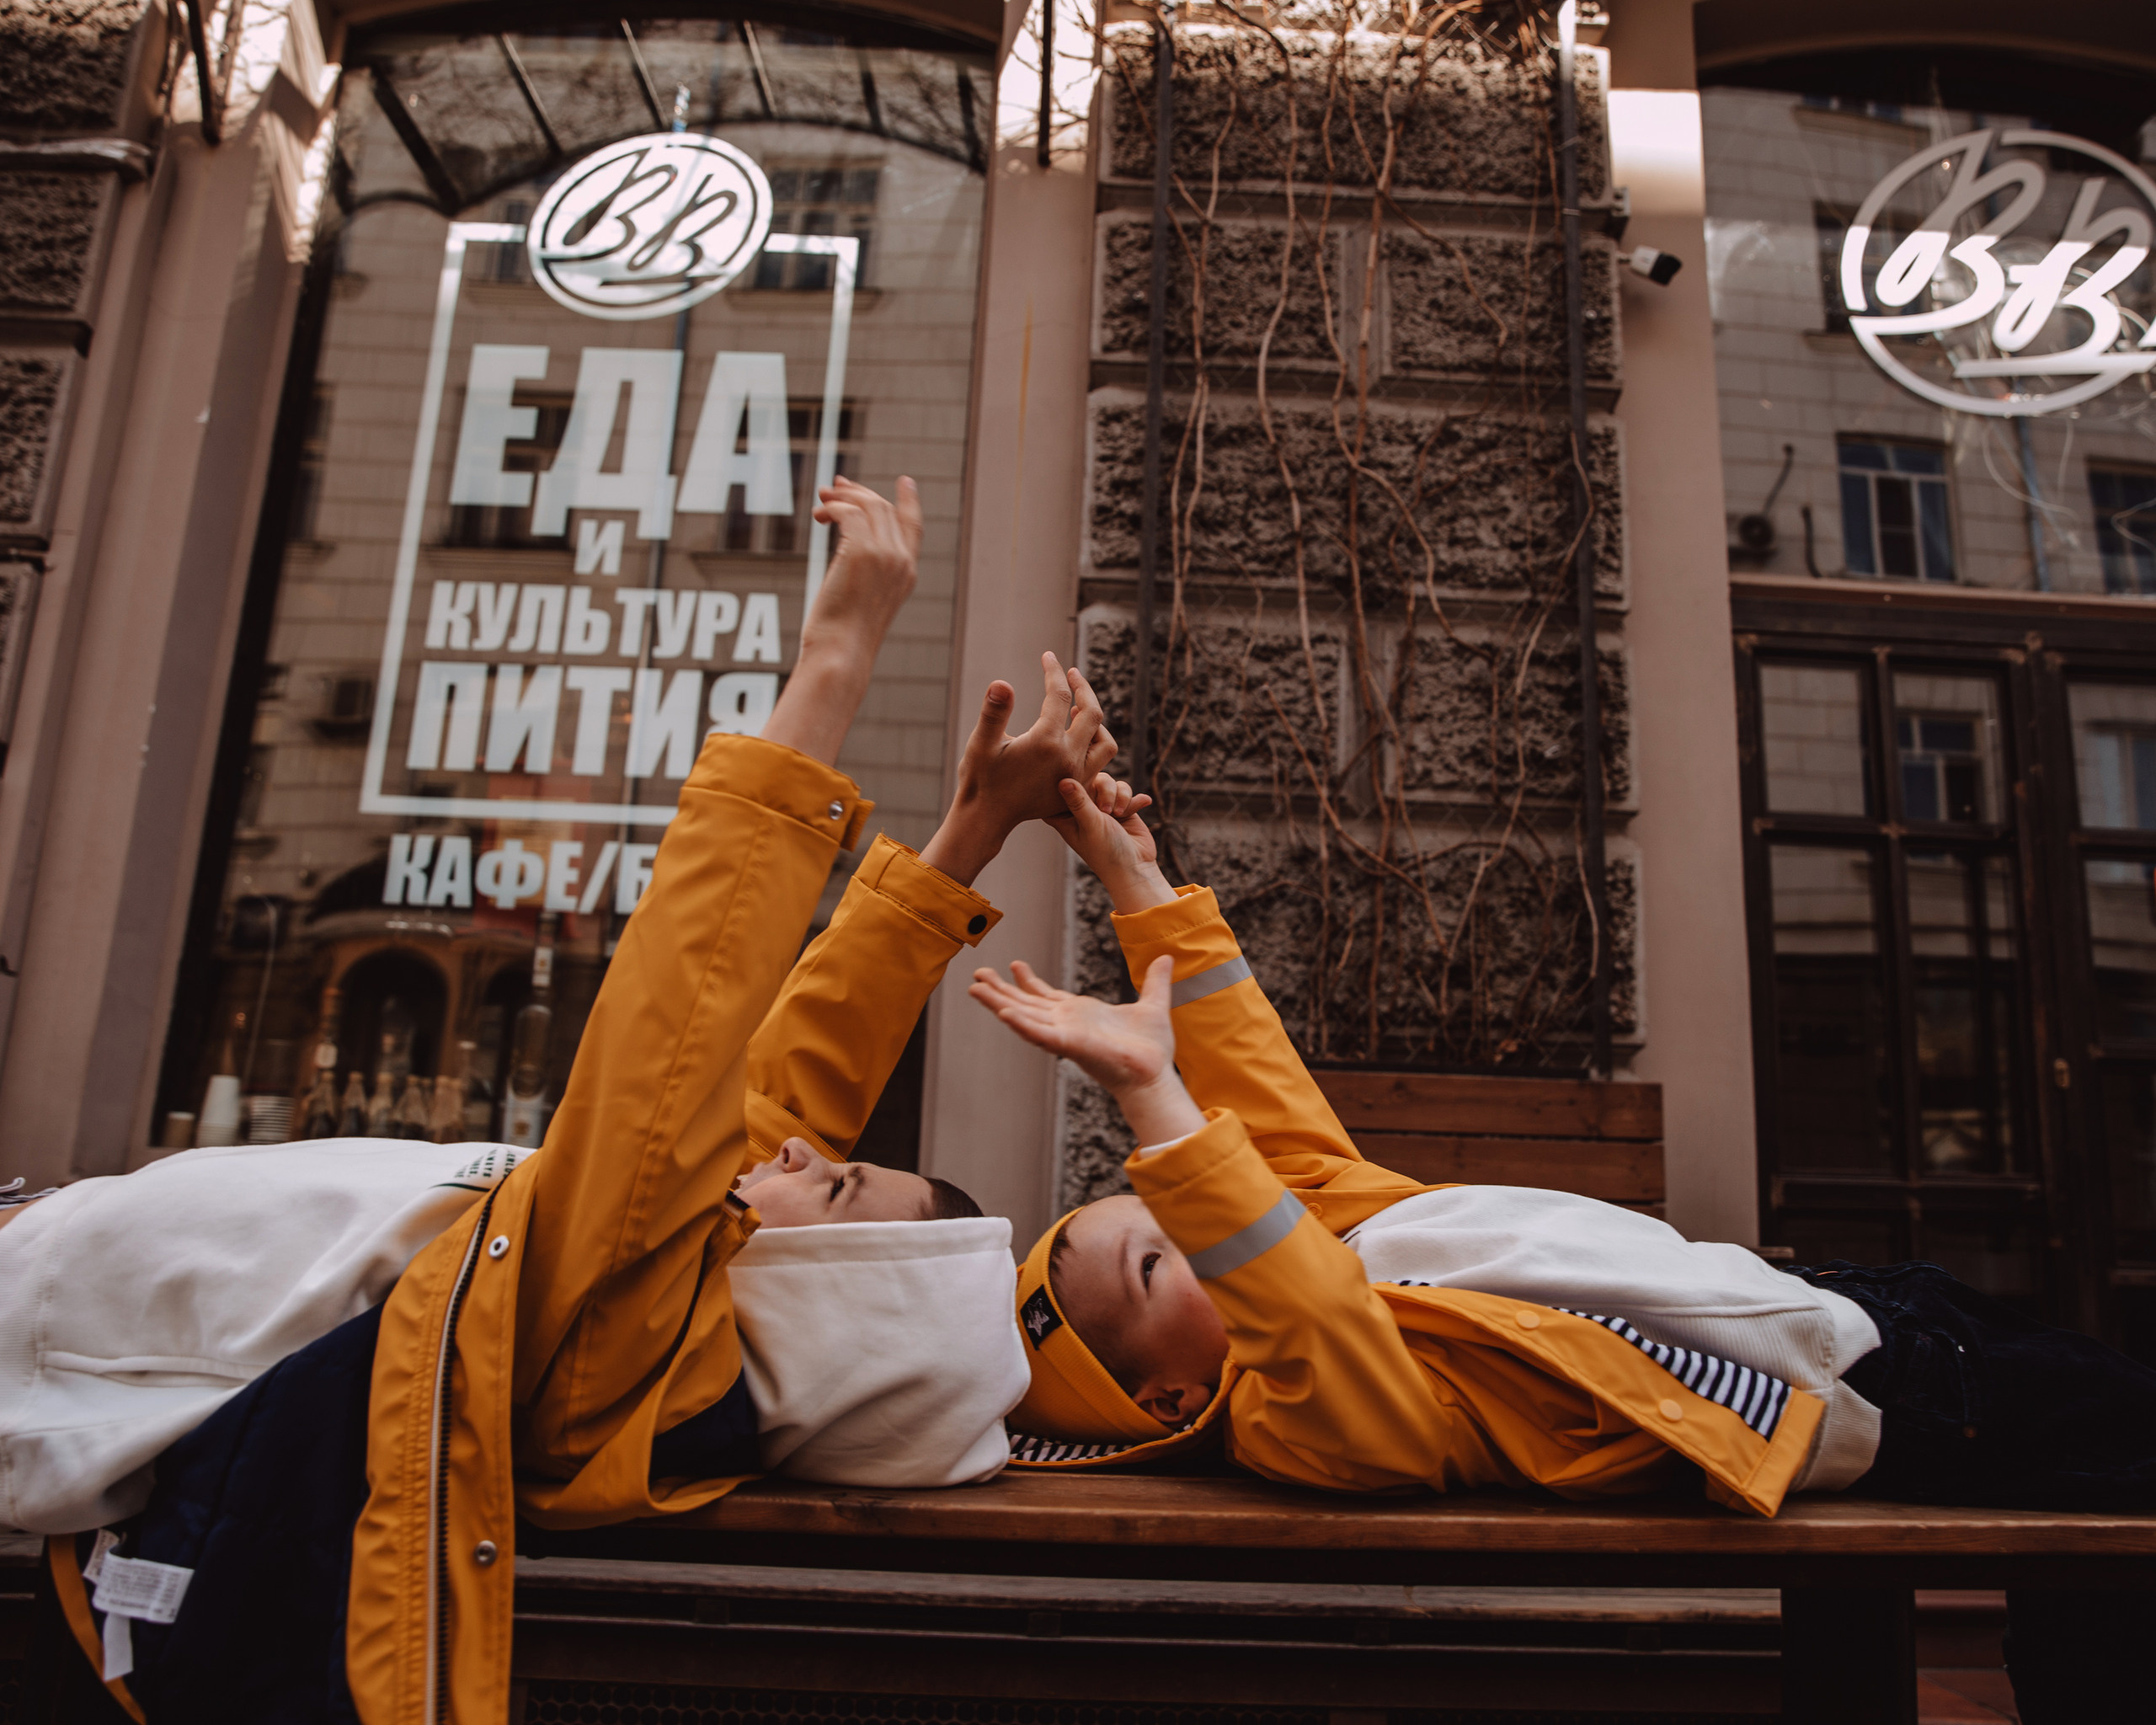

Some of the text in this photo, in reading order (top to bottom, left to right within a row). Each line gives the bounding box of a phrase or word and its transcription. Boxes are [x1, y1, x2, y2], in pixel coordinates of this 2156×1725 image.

[450, 344, 794, 540] ЕДА
[574, 519, 625, 576] И
[424, 580, 782, 663] КУЛЬТУРА
[406, 660, 779, 779] ПИТИЯ
